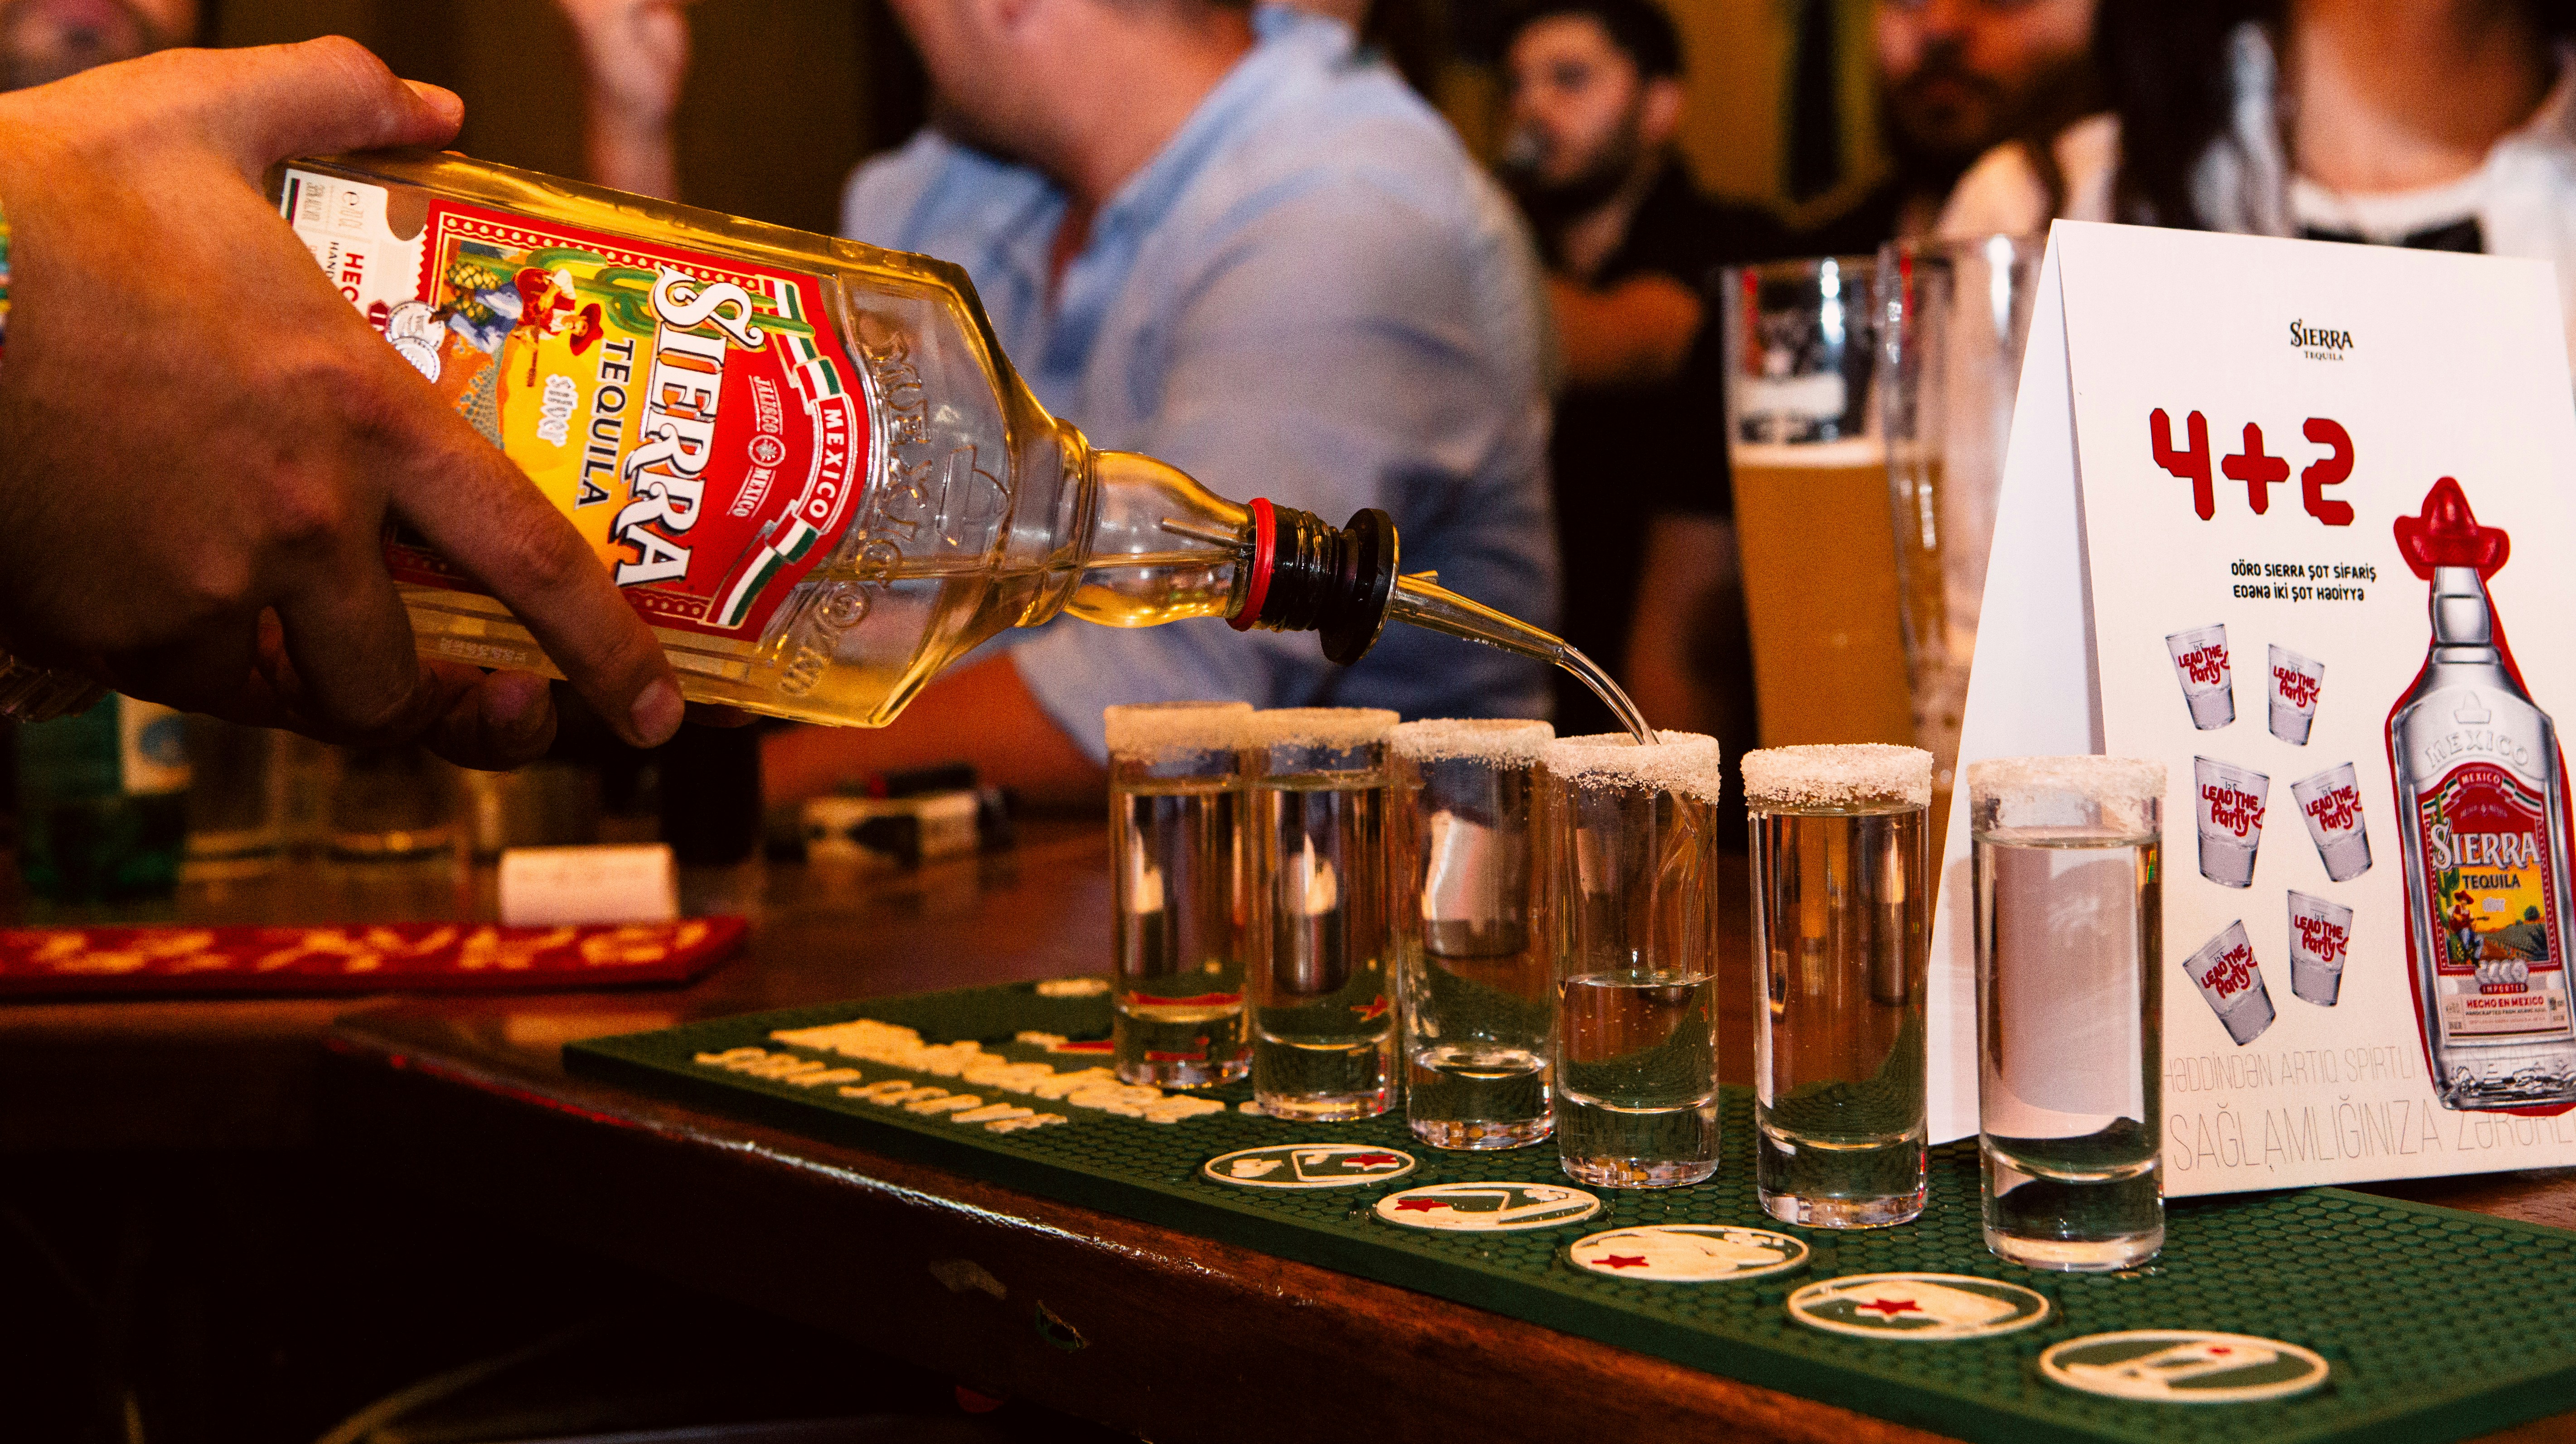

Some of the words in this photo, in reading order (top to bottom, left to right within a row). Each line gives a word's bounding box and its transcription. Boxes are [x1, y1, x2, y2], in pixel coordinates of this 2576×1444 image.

[2290, 318, 2354, 351] SIERRA
[2304, 349, 2344, 361] TEQUILA
[753, 375, 779, 434] JALISCO
[578, 338, 635, 505] TEQUILA
[615, 265, 765, 586] SIERRA
[809, 408, 845, 518] MEXICO
[2150, 407, 2354, 526] 4+2
[732, 466, 772, 517] MEXICO
[2264, 563, 2305, 578] SIERRA
[2308, 565, 2329, 581] ŞOT
[2273, 581, 2289, 599] İKİ
[2291, 586, 2313, 603] ŞOT
[2178, 650, 2203, 668] LEAD
[2201, 644, 2223, 662] THE
[2273, 665, 2296, 684] LEAD
[2298, 673, 2316, 690] THE
[2425, 729, 2528, 769] MEXICO
[2461, 772, 2500, 785] MEXICO
[2202, 783, 2233, 805] LEAD
[2234, 790, 2258, 811] THE
[2306, 795, 2333, 817] LEAD
[2331, 785, 2354, 805] THE
[2211, 801, 2250, 837] Party
[2431, 816, 2542, 871] SIERRA
[2462, 874, 2522, 889] TEQUILA
[2294, 914, 2321, 934] LEAD
[2322, 921, 2344, 940] THE
[2201, 961, 2228, 989] LEAD
[2224, 943, 2247, 967] THE
[2467, 999, 2497, 1009] HECHO
[2499, 998, 2510, 1008] EN
[2512, 995, 2544, 1007] MEXICO
[2281, 1049, 2339, 1085] ARTIQ
